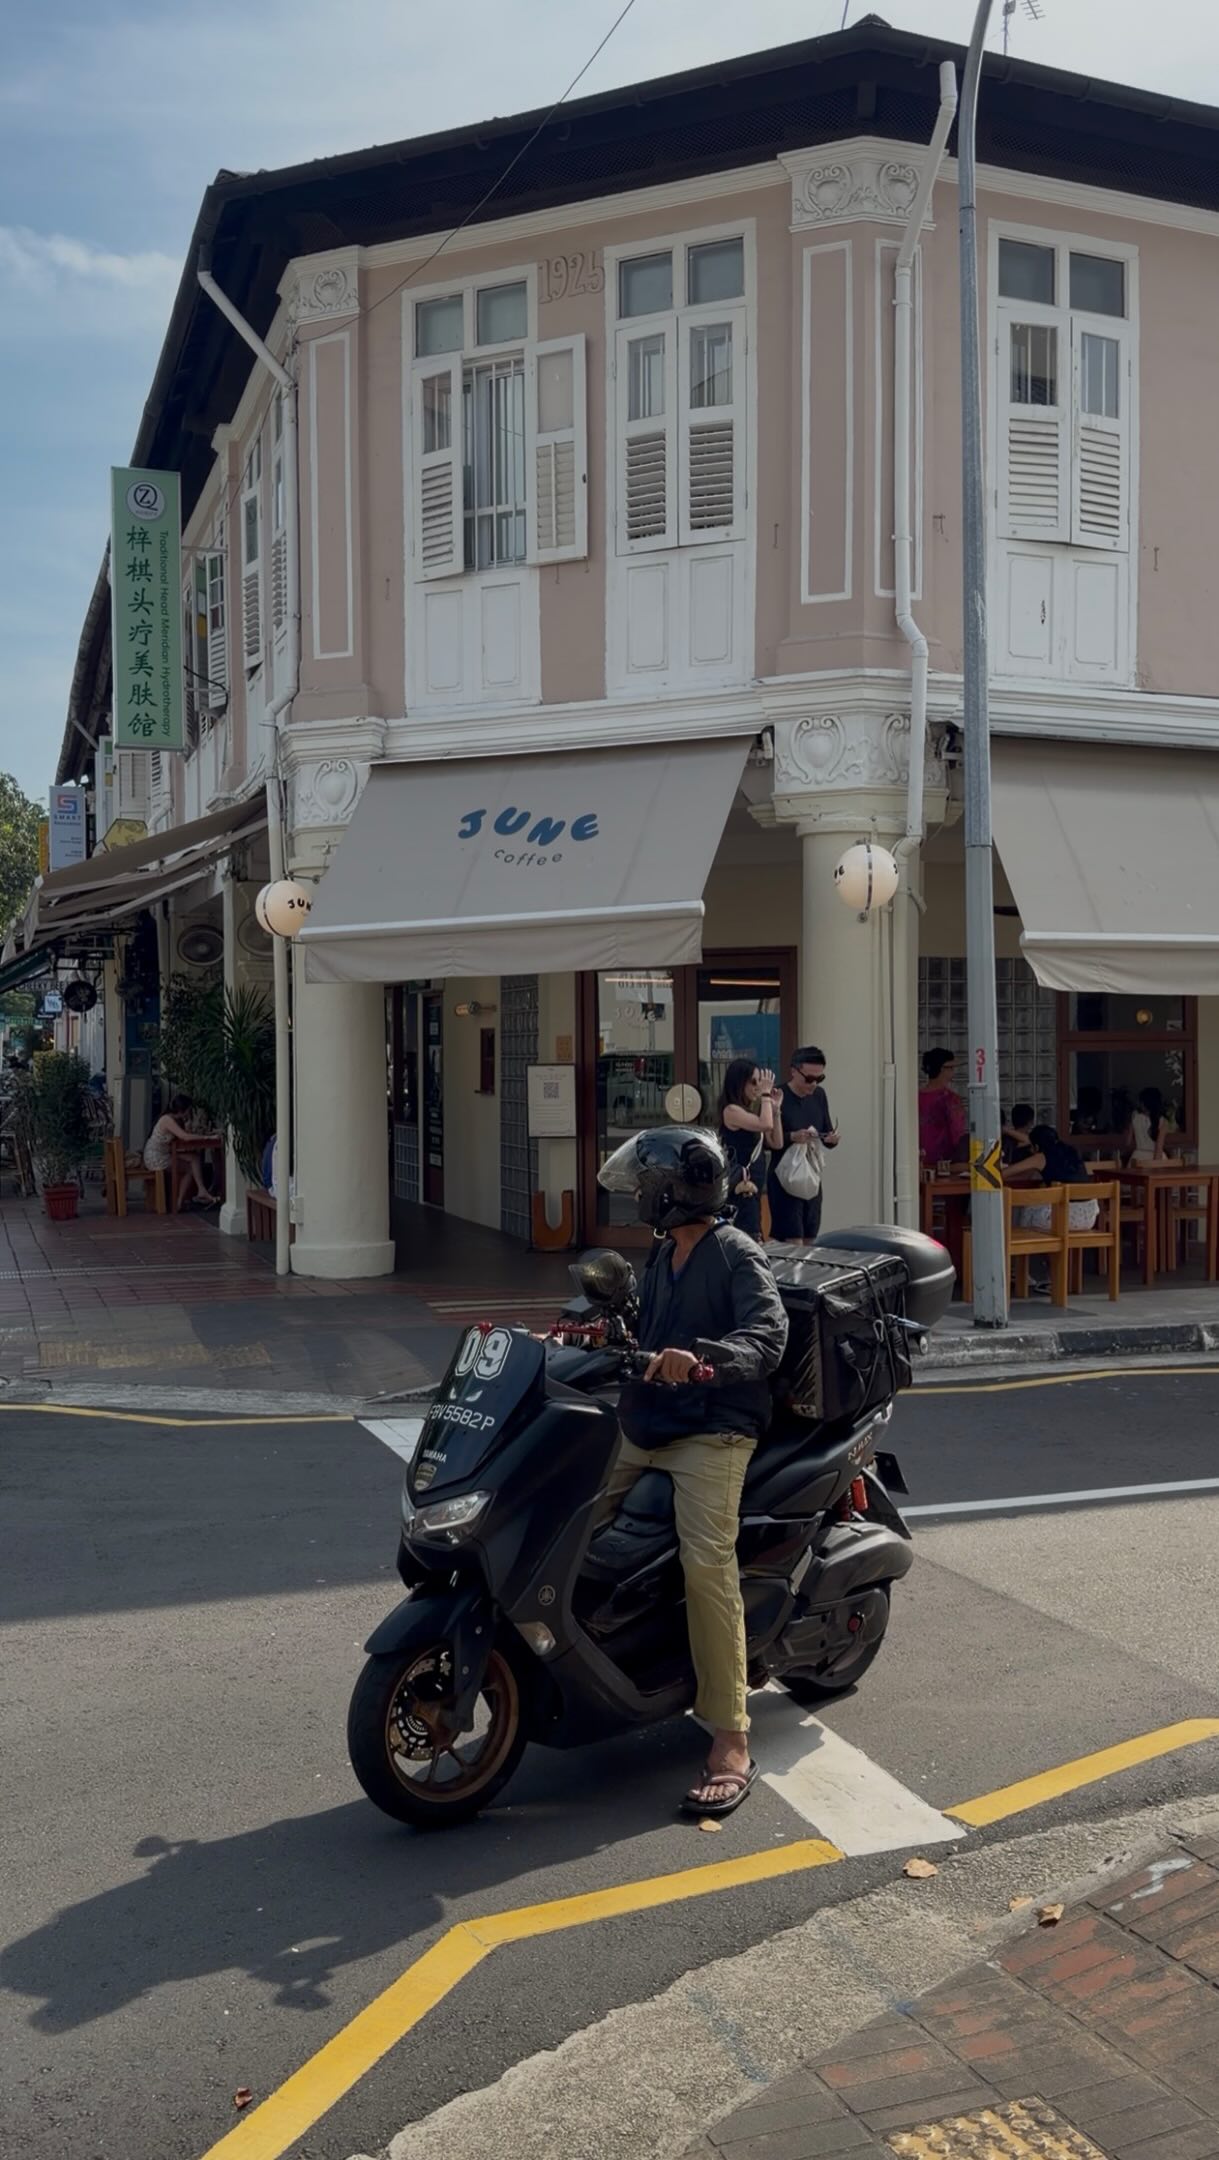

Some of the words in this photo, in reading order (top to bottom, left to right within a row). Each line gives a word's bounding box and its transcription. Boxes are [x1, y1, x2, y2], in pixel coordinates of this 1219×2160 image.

[538, 252, 605, 304] 1925
[160, 530, 169, 583] Traditional
[160, 587, 169, 616] Head
[125, 525, 158, 737] 梓棋头疗美肤馆
[160, 619, 171, 663] Meridian
[160, 666, 171, 736] Hydrotherapy
[458, 805, 599, 846] JUNE
[494, 849, 564, 867] coffee
[455, 1327, 512, 1380] 09
